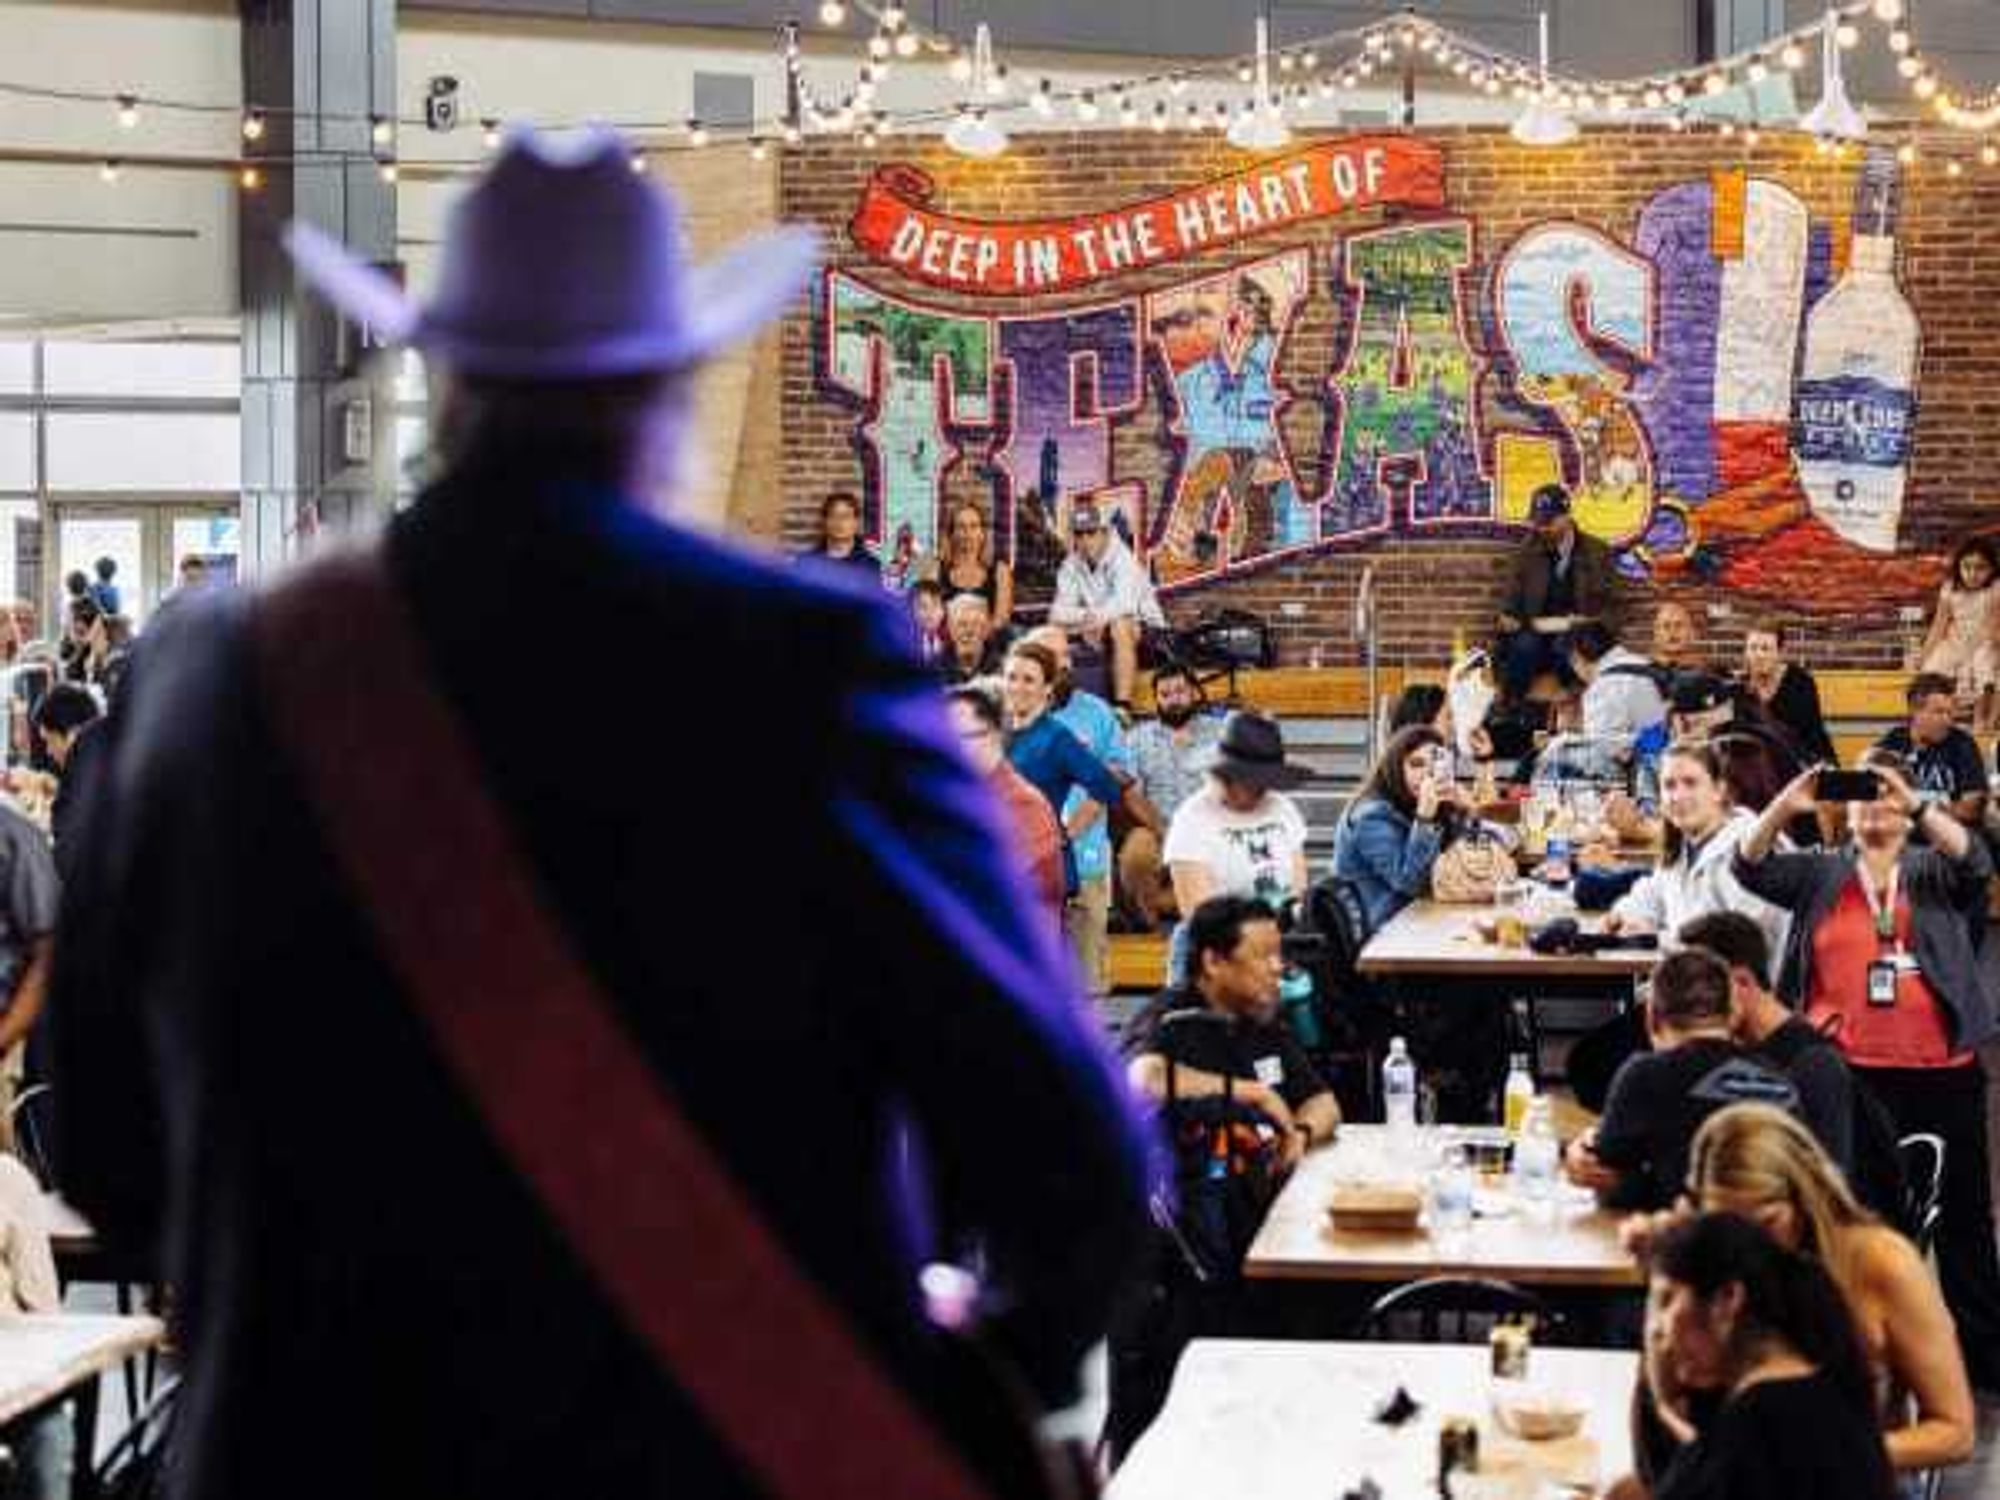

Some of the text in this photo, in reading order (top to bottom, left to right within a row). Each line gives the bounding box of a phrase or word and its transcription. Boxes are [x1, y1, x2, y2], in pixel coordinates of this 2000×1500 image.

[891, 147, 1388, 287] DEEP IN THE HEART OF
[822, 218, 1658, 594] TEXAS
